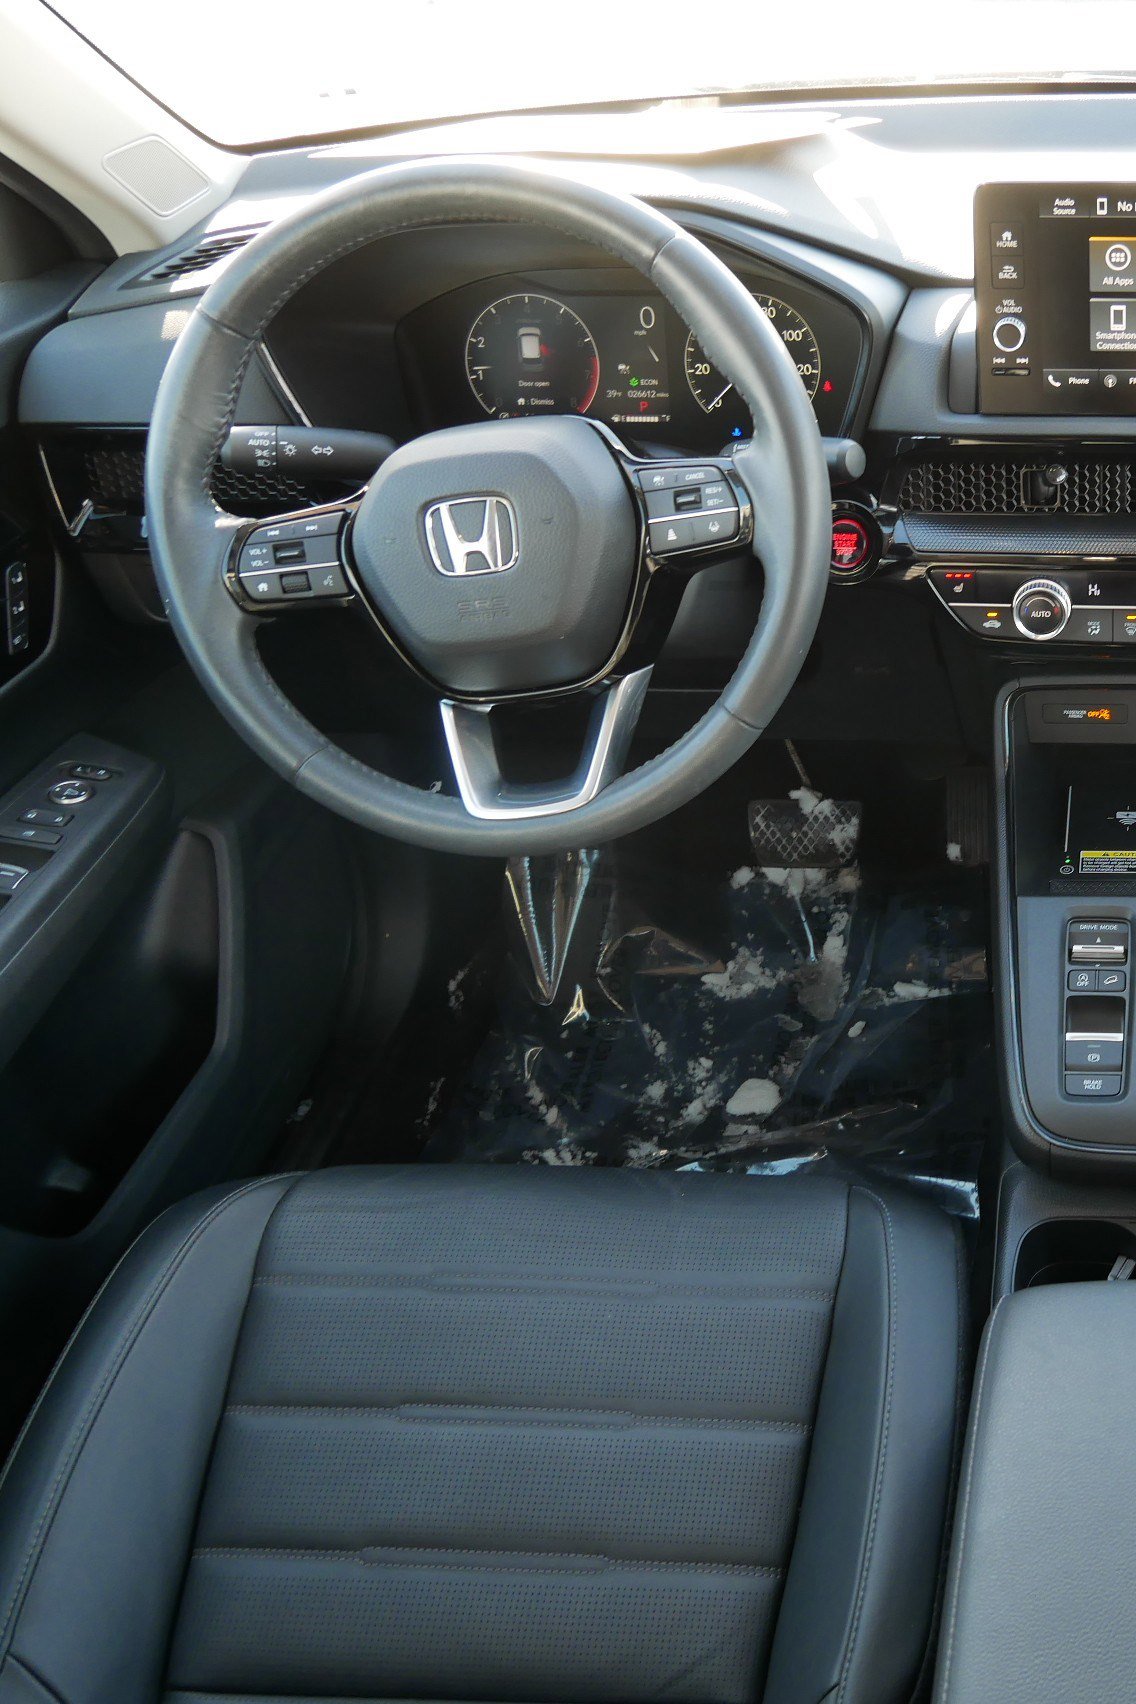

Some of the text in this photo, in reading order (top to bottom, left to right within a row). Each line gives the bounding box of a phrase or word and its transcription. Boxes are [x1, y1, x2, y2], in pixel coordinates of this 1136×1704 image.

[1053, 198, 1075, 207] Audio
[1117, 201, 1132, 212] No
[1053, 207, 1076, 216] Source
[996, 240, 1018, 248] HOME
[1103, 276, 1134, 287] All Apps
[1002, 299, 1015, 307] VOL
[1002, 306, 1023, 314] AUDIO
[640, 306, 655, 329] 0
[781, 330, 803, 342] 100
[477, 337, 485, 347] 2
[694, 363, 711, 375] 20
[797, 363, 812, 375] 20
[477, 370, 483, 380] 1
[1068, 377, 1090, 385] Phone
[627, 390, 656, 398] 026612
[530, 398, 555, 406] Dismiss
[640, 401, 648, 411] P
[685, 472, 705, 480] CANCEL
[832, 533, 858, 541] ENGINE
[1087, 710, 1100, 718] OFF
